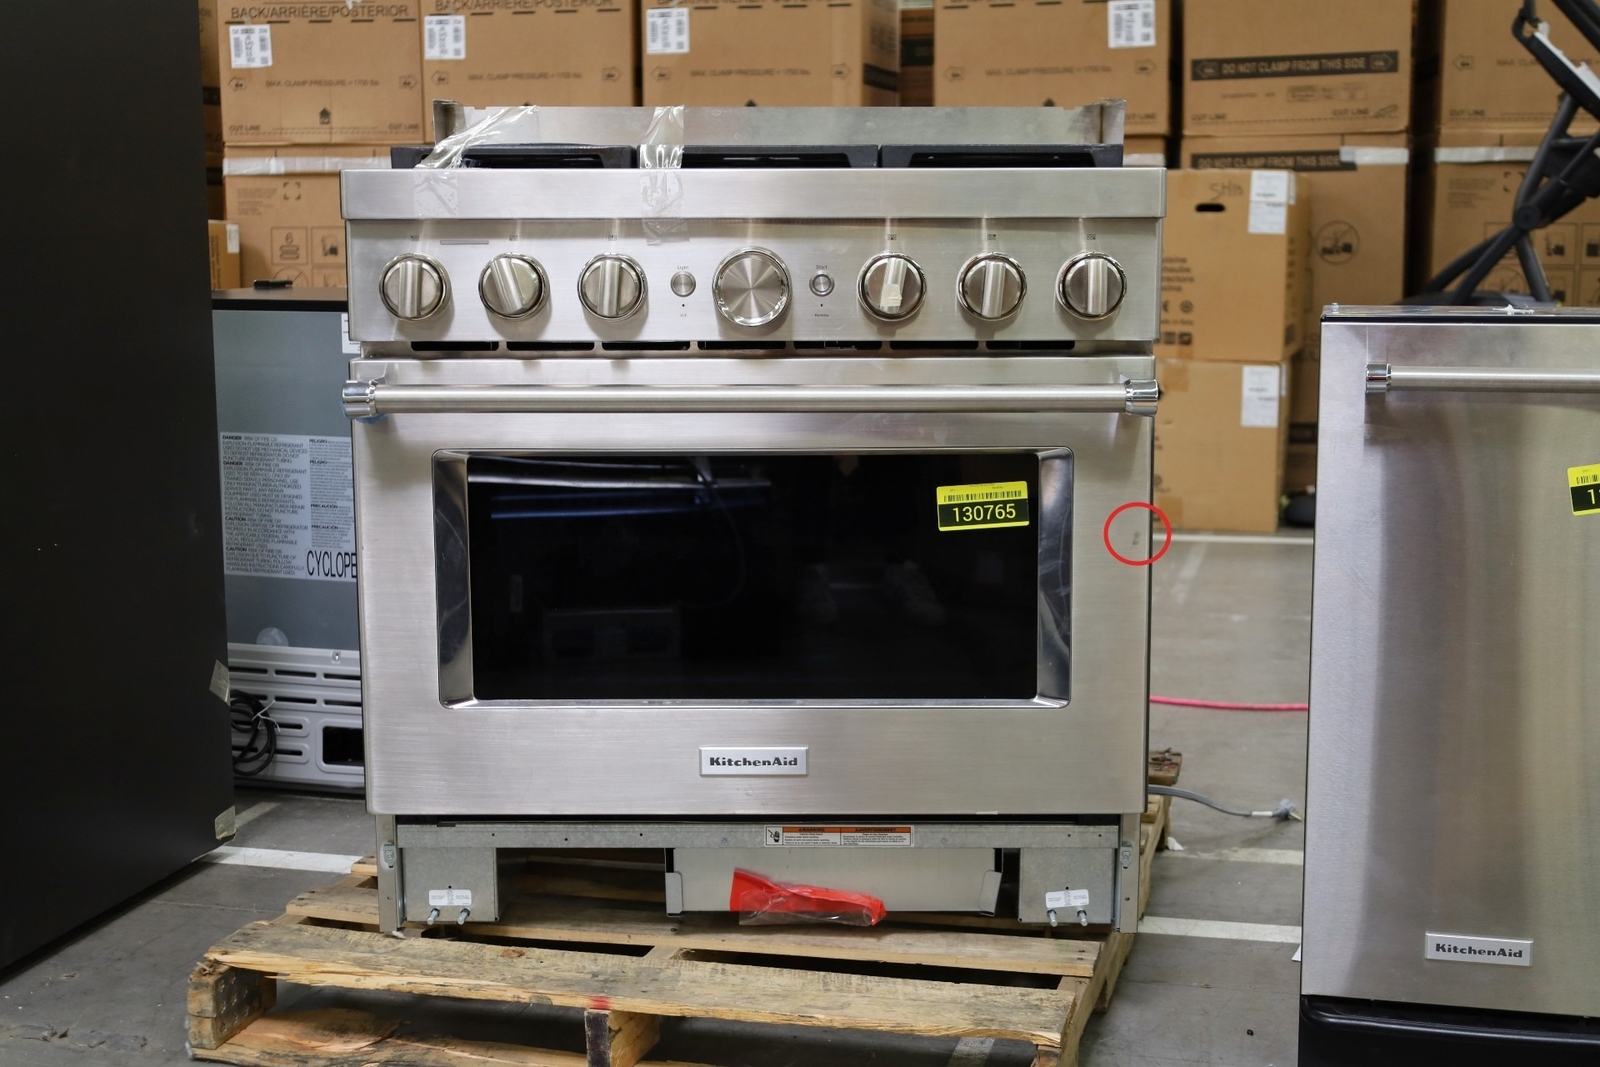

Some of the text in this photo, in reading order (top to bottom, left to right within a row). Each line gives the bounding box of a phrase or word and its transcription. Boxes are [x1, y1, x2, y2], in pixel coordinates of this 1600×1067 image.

[1222, 57, 1366, 74] DO NOT CLAMP FROM THIS SIDE
[952, 503, 1016, 522] 130765
[710, 757, 798, 766] KitchenAid
[1436, 943, 1523, 958] KitchenAid
